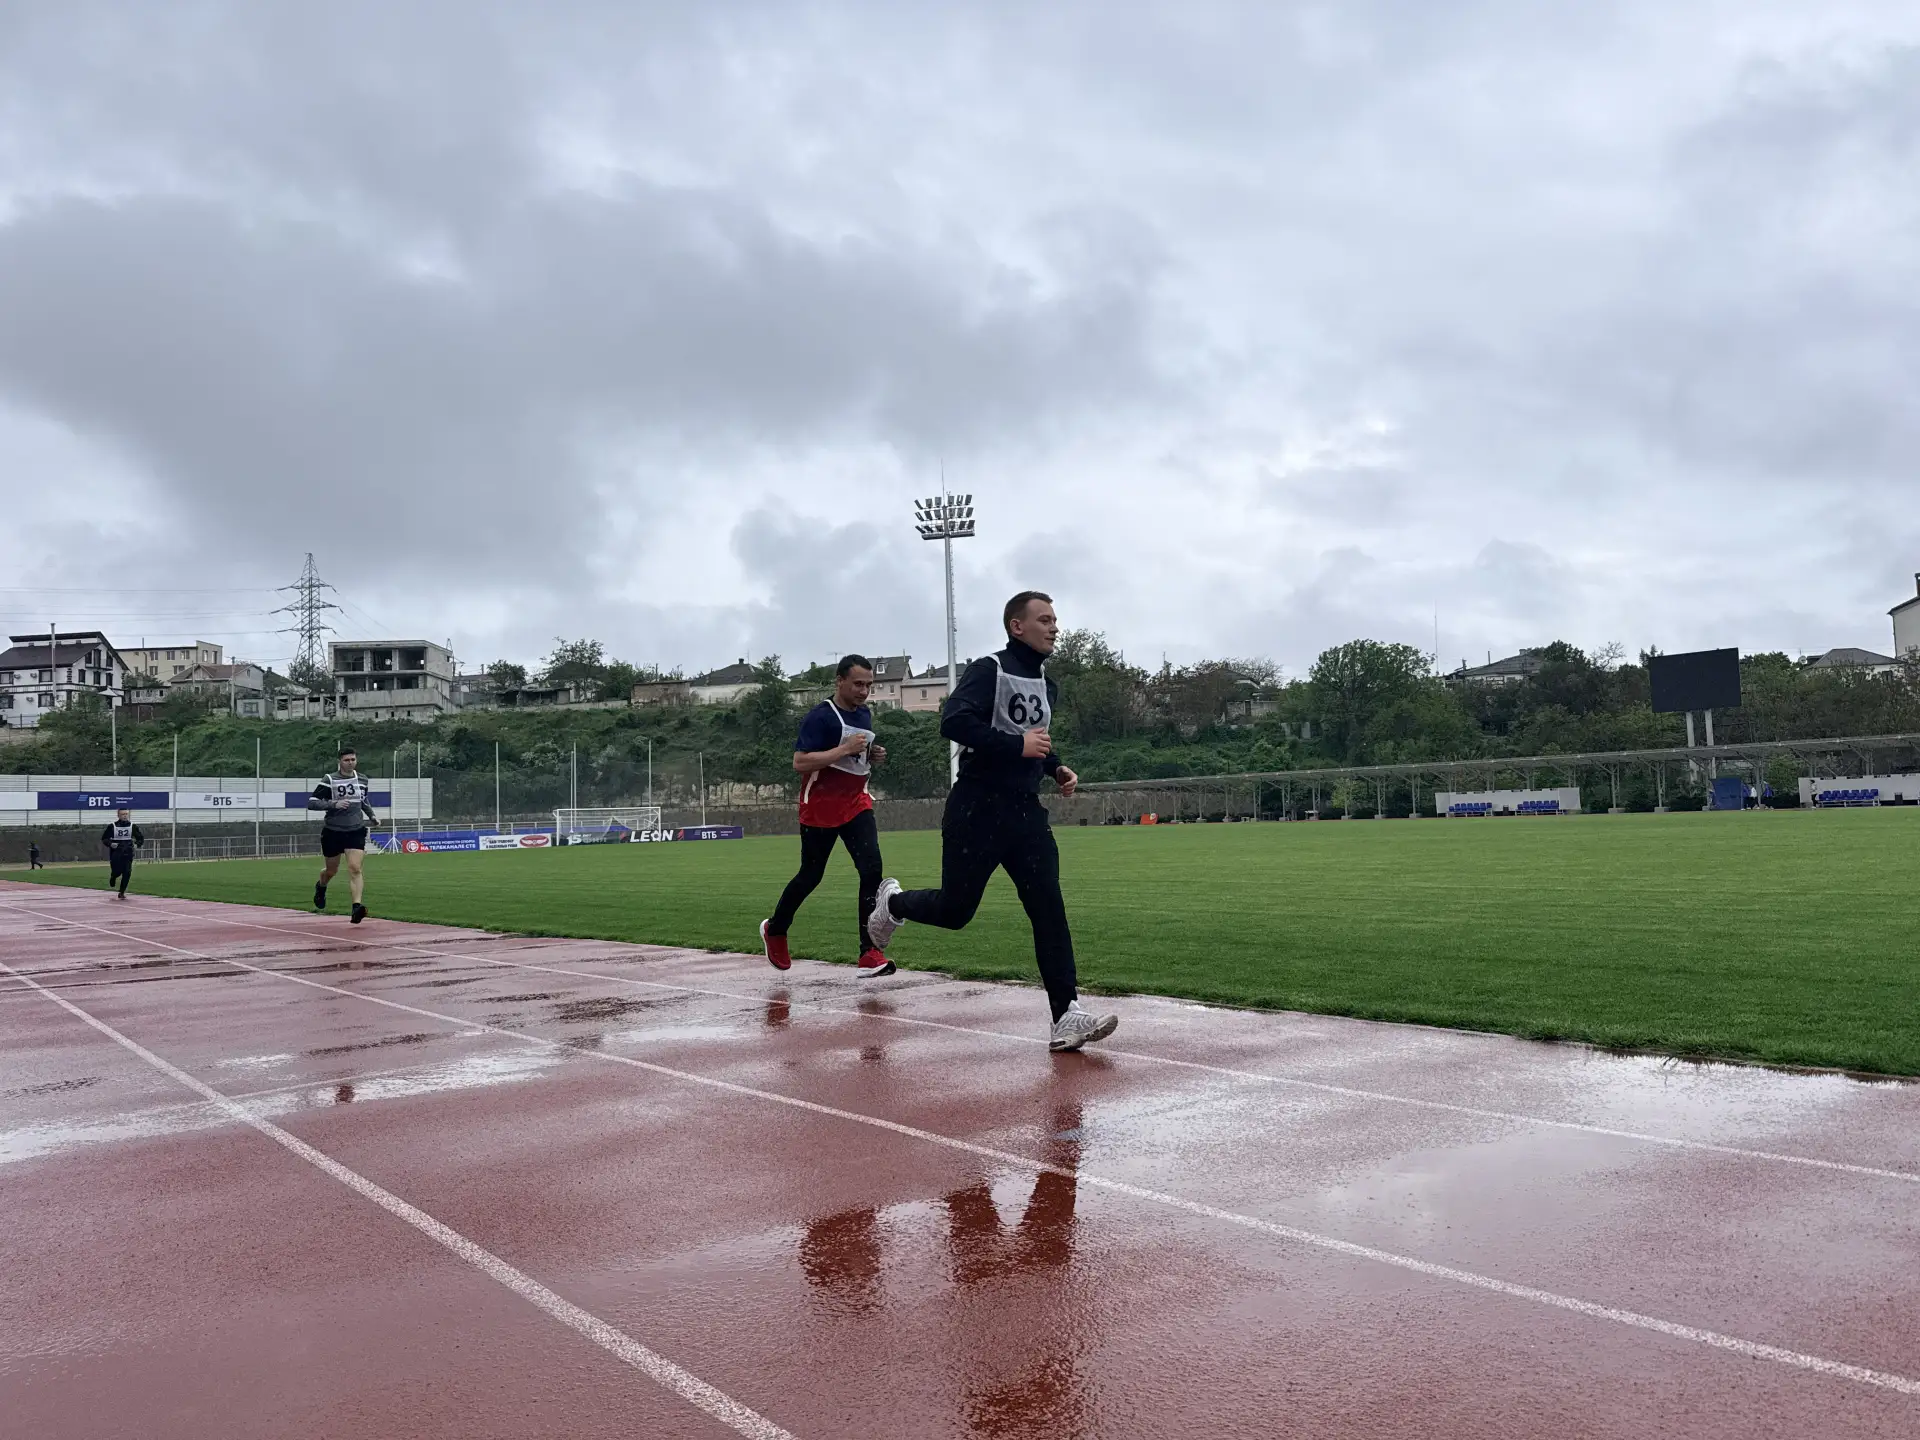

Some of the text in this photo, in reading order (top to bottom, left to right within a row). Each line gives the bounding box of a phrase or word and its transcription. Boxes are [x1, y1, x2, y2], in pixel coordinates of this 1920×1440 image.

[1008, 693, 1043, 725] 63
[337, 783, 355, 797] 93
[88, 796, 111, 807] ВТБ
[212, 796, 232, 806] ВТБ
[117, 829, 129, 837] 82
[701, 830, 717, 839] ВТБ
[566, 834, 582, 846] 15
[429, 843, 465, 851] ТЕЛЕКАНАЛЕ
